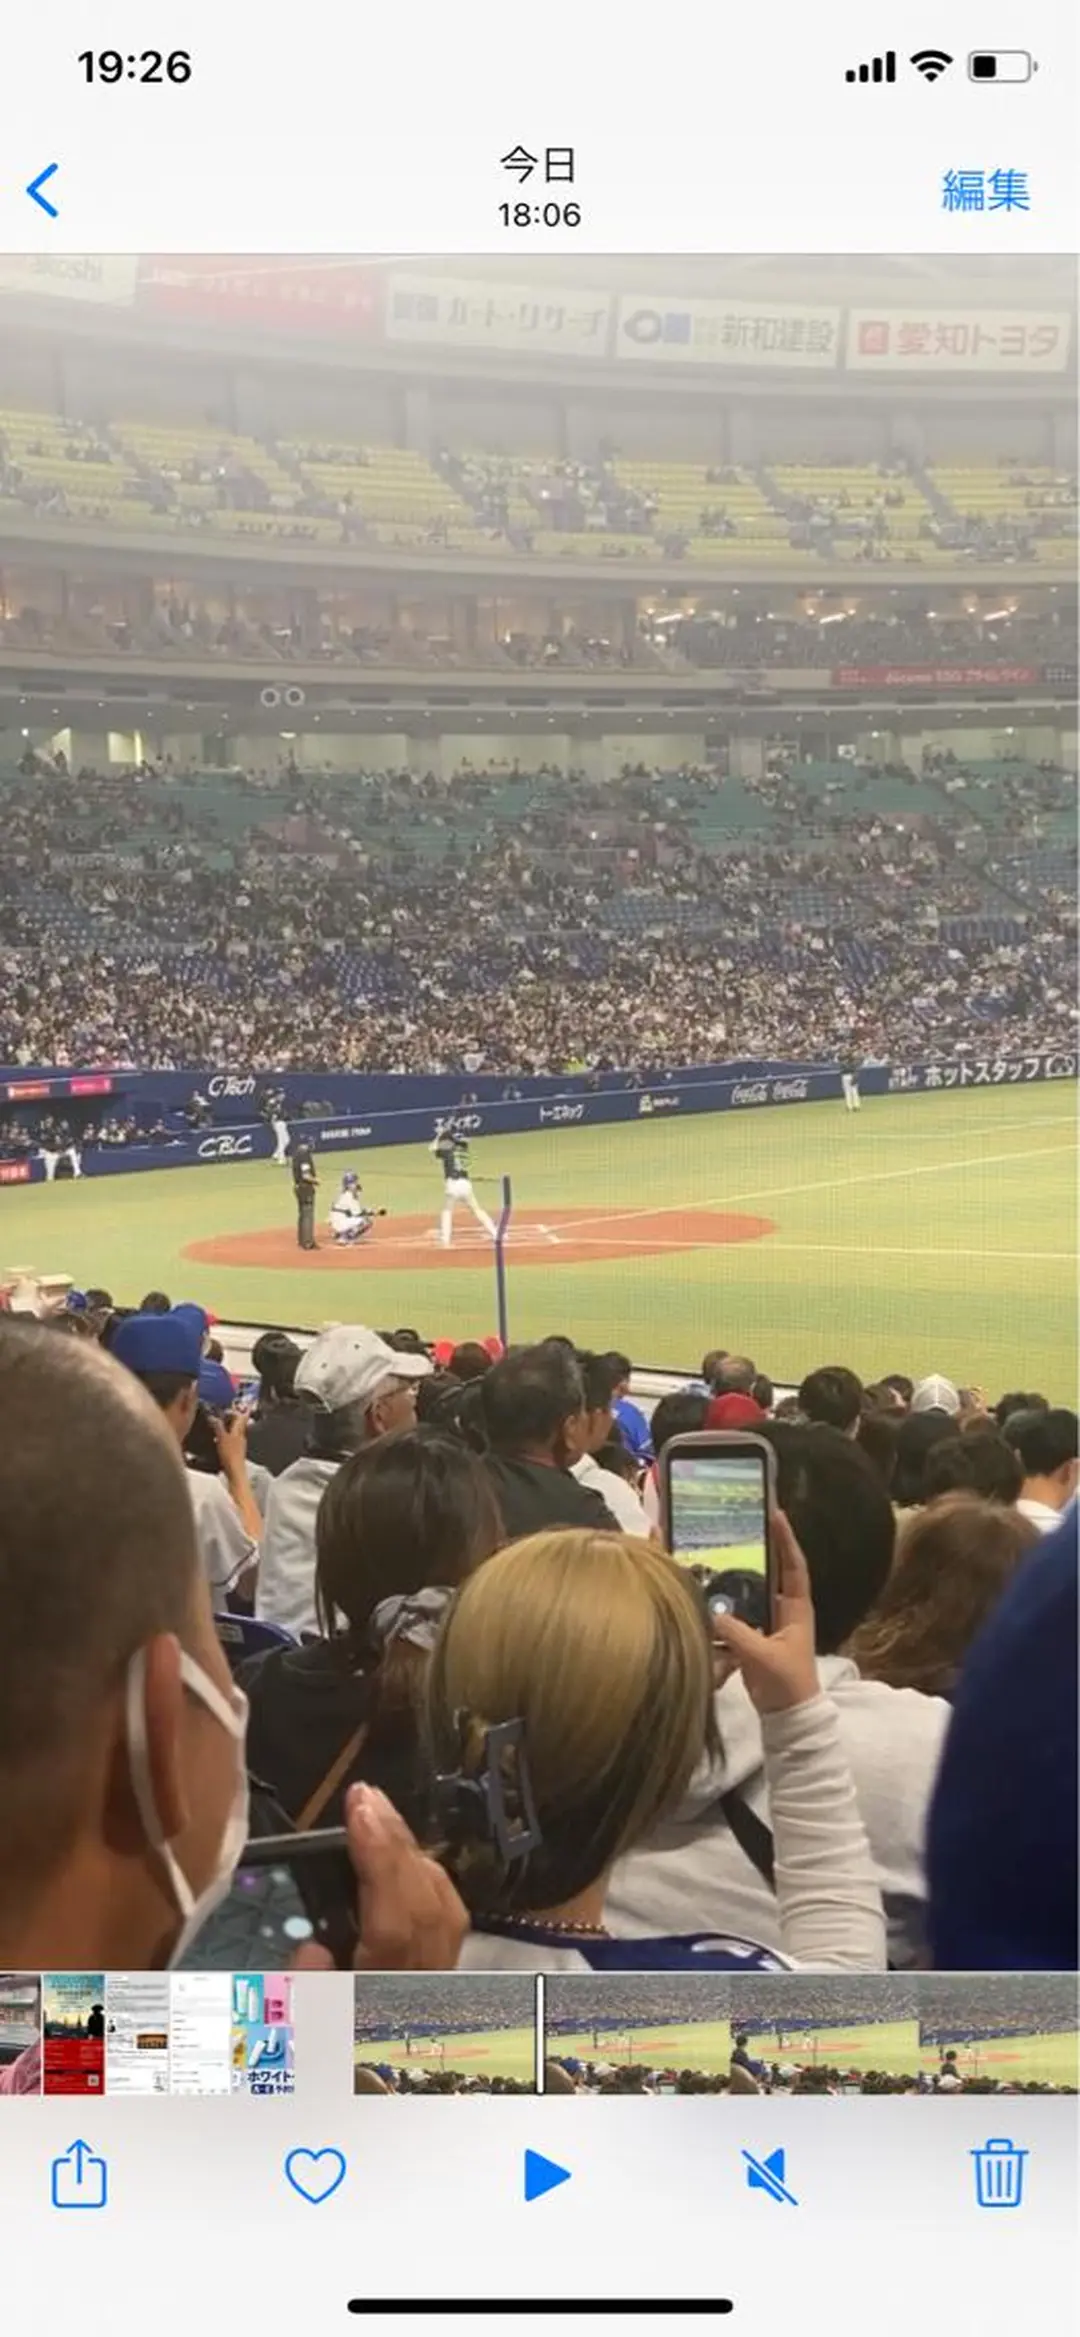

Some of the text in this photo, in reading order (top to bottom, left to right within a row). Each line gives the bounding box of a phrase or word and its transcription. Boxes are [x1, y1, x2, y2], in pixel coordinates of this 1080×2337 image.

[78, 50, 192, 84] 19:26
[500, 145, 574, 184] 今日
[942, 168, 1030, 212] 編集
[498, 202, 581, 227] 18:06
[894, 320, 1060, 357] 愛知トヨタ
[924, 1058, 1040, 1087] ホットスタッフ
[197, 1134, 252, 1158] CBC
